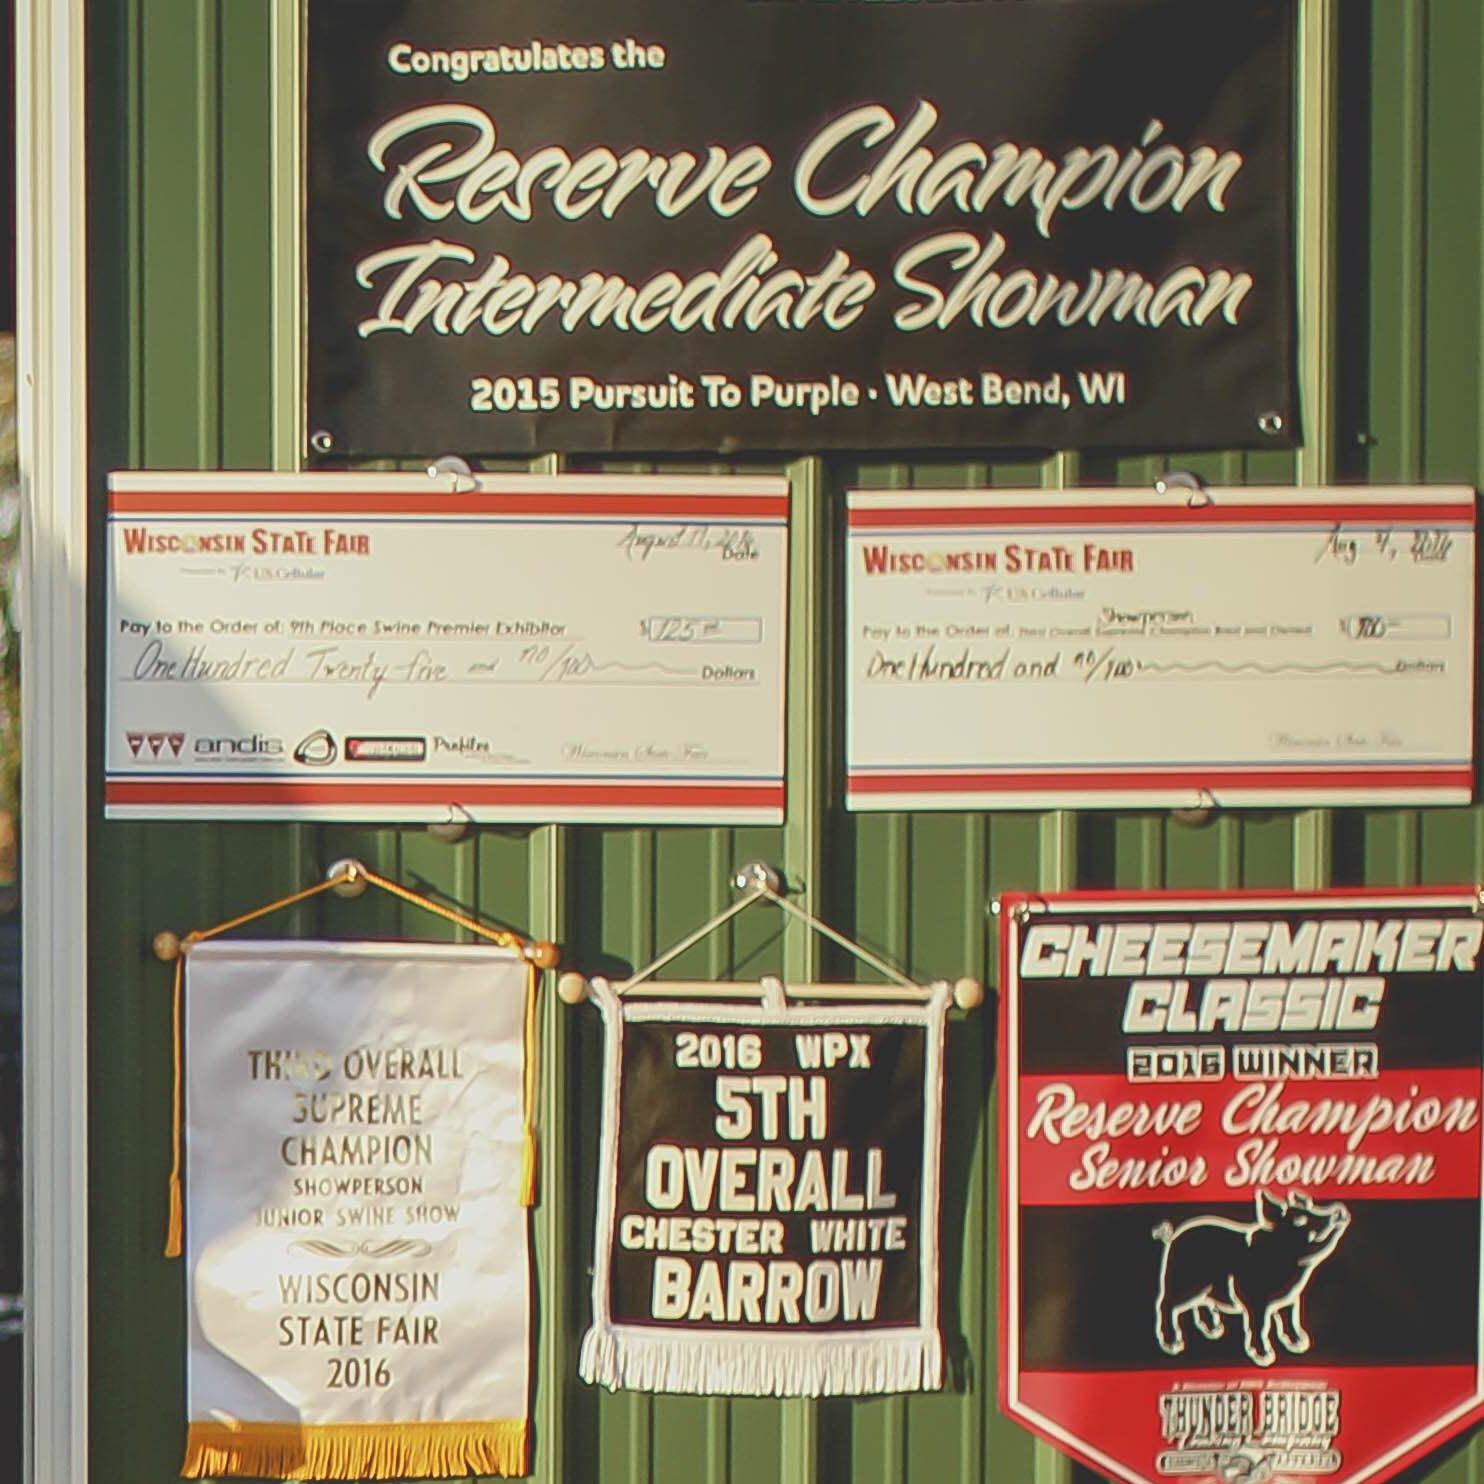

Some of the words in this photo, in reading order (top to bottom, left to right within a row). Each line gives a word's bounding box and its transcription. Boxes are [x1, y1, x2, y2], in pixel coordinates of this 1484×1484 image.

[389, 41, 606, 80] Congratulates
[612, 39, 665, 73] the
[366, 102, 773, 226] Reserve
[795, 96, 1242, 238] Champion
[356, 233, 874, 341] Intermediate
[890, 232, 1252, 333] Showman
[471, 377, 561, 412] 2015
[569, 375, 695, 412] Pursuit
[702, 375, 742, 411] To
[749, 375, 861, 419] Purple
[885, 374, 974, 408] West
[981, 374, 1072, 413] Bend,
[1077, 374, 1126, 405] WI
[324, 528, 370, 556] FAIR
[1084, 544, 1134, 573] FAIR
[120, 620, 150, 636] Pay
[157, 621, 172, 634] to
[178, 620, 204, 634] the
[210, 620, 258, 634] Order
[321, 619, 367, 635] Place
[428, 621, 490, 635] Premier
[134, 640, 175, 681] One
[182, 644, 295, 681] Hundred
[702, 665, 755, 681] Dollars
[1013, 651, 1061, 680] and
[194, 734, 284, 754] andis
[1020, 919, 1482, 978] CHEESEMAKER
[1122, 977, 1385, 1033] CLASSIC
[344, 1048, 463, 1080] OVERALL
[675, 1033, 762, 1069] 2016
[796, 1033, 872, 1069] WPX
[1128, 1045, 1225, 1082] 2016
[1233, 1043, 1379, 1079] WINNER
[293, 1093, 423, 1124] SUPREME
[715, 1076, 827, 1141] 5TH
[1026, 1082, 1202, 1142] Reserve
[1220, 1081, 1480, 1154] Champion
[281, 1134, 432, 1166] CHAMPION
[1069, 1143, 1208, 1191] Senior
[1224, 1143, 1435, 1188] Showman
[294, 1177, 424, 1197] SHOWPERSON
[644, 1145, 897, 1211] OVERALL
[256, 1208, 324, 1227] JUNIOR
[336, 1206, 394, 1226] SWINE
[406, 1204, 460, 1224] SHOW
[619, 1214, 783, 1254] CHESTER
[809, 1217, 907, 1251] WHITE
[278, 1272, 439, 1304] WISCONSIN
[651, 1257, 883, 1323] BARROW
[279, 1316, 363, 1346] STATE
[377, 1316, 440, 1345] FAIR
[327, 1357, 391, 1388] 2016
